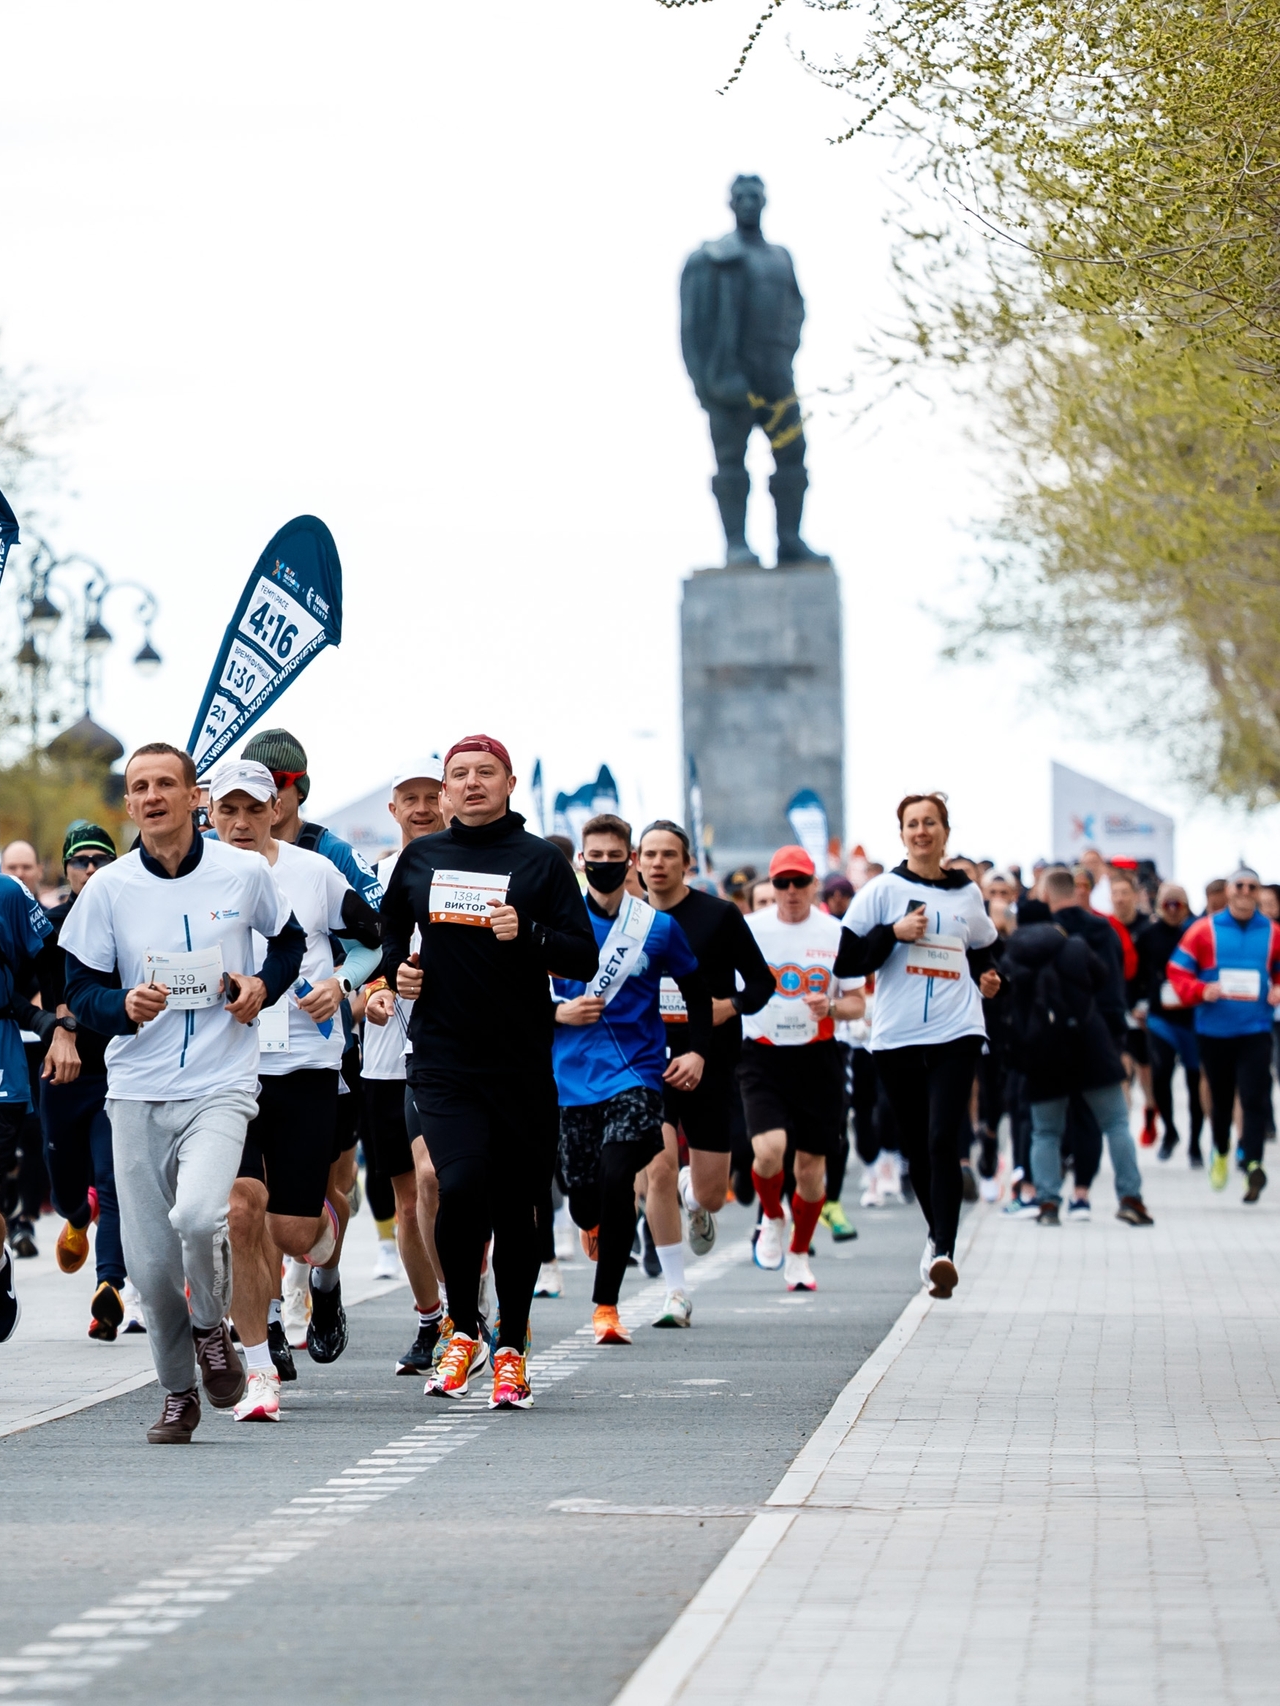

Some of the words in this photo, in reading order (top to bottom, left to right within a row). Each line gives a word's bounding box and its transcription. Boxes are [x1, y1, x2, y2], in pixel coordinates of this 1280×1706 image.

[249, 601, 299, 659] 4:16
[226, 660, 256, 695] 1:30
[230, 723, 240, 733] В
[238, 683, 273, 726] КАЖДОМ
[454, 890, 481, 902] 1384
[444, 901, 486, 912] ВИКТОР
[631, 901, 643, 925] 3754
[927, 949, 949, 961] 1640
[166, 982, 207, 996] СЕРГЕЙ
[172, 974, 196, 986] 139
[212, 1266, 224, 1297] PROUD
